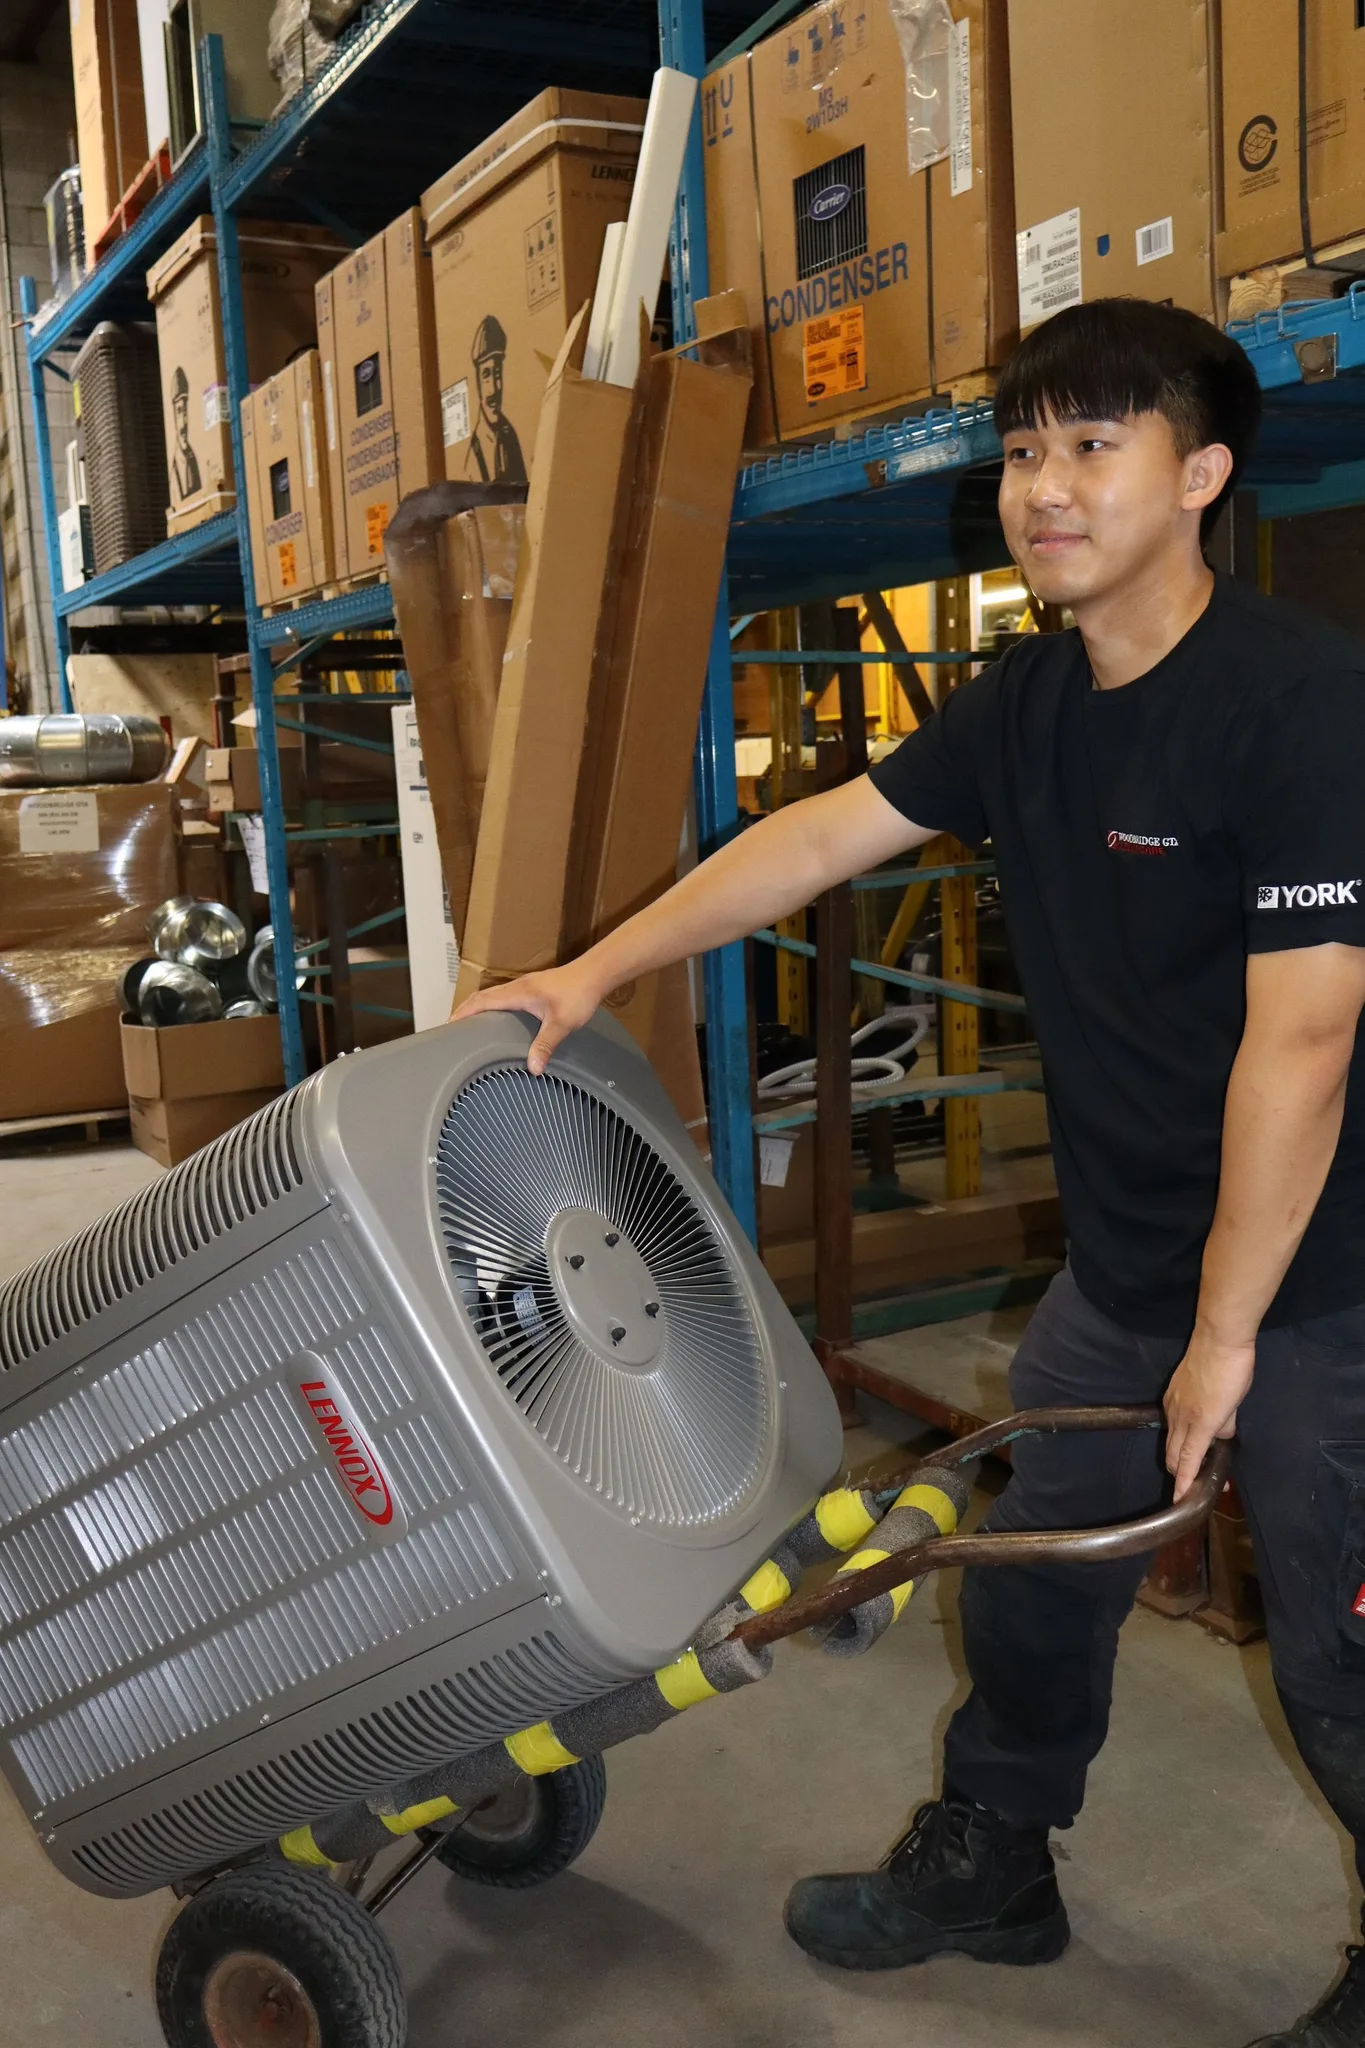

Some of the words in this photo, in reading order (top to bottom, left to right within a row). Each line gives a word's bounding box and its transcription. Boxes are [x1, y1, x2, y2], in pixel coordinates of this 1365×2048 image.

[813, 192, 846, 215] Carrier
[767, 241, 909, 333] CONDENSER
[1281, 880, 1358, 908] YORK
[300, 1381, 381, 1496] LENNOX
